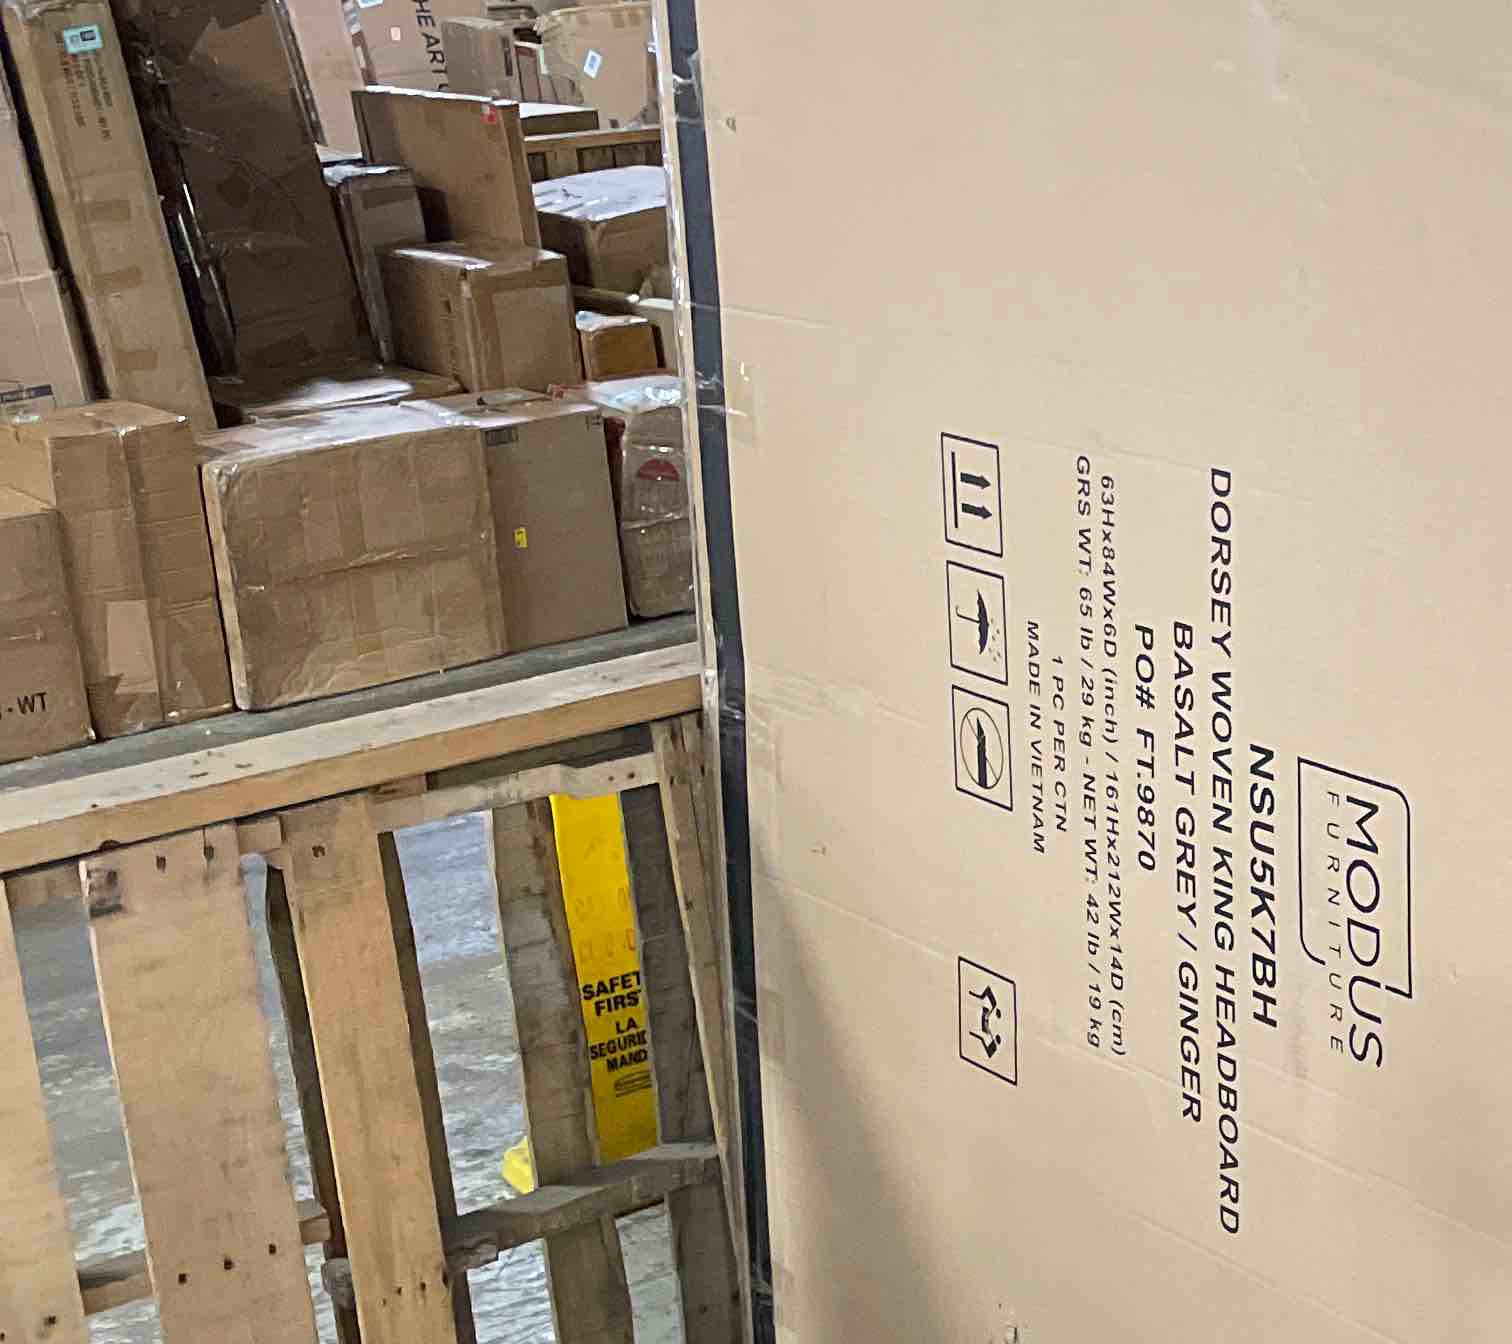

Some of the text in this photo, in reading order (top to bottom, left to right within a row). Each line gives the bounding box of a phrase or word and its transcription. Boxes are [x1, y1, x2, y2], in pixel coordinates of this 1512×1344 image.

[1076, 454, 1091, 516] GRS
[1077, 527, 1093, 577] WT:
[1100, 474, 1118, 659] 63Hx84Wx6D
[1079, 586, 1093, 617] 65
[1080, 626, 1094, 652] lb
[1052, 670, 1064, 712] PC
[1080, 677, 1095, 710] 29
[1102, 667, 1121, 745] (inch)
[1027, 620, 1046, 855] MADE IN VIETNAM
[1053, 718, 1066, 770] PER
[1078, 717, 1094, 750] kg
[1134, 623, 1157, 872] PO# FT.9870
[1053, 776, 1067, 833] CTN
[1083, 772, 1097, 829] NET
[1083, 835, 1099, 886] WT:
[1173, 620, 1202, 1123] BASALT GREY / GINGER
[1210, 466, 1240, 1235] DORSEY WOVEN KING HEADBOARD
[1104, 769, 1126, 992] 161Hx212Wx14D
[1249, 742, 1278, 1028] NSU5K7BH
[1086, 892, 1100, 923] 42
[1326, 790, 1344, 1055] FURNITURE
[1345, 794, 1384, 1068] MODUS
[1086, 931, 1100, 956] lb
[582, 971, 641, 1001] SAFET
[594, 989, 641, 1017] FIRS
[1087, 981, 1101, 1009] 19
[589, 1030, 648, 1061] SEGURI
[615, 1017, 637, 1034] LA
[1086, 1018, 1102, 1050] kg
[1108, 999, 1128, 1057] (cm)
[606, 1047, 648, 1073] MAND
